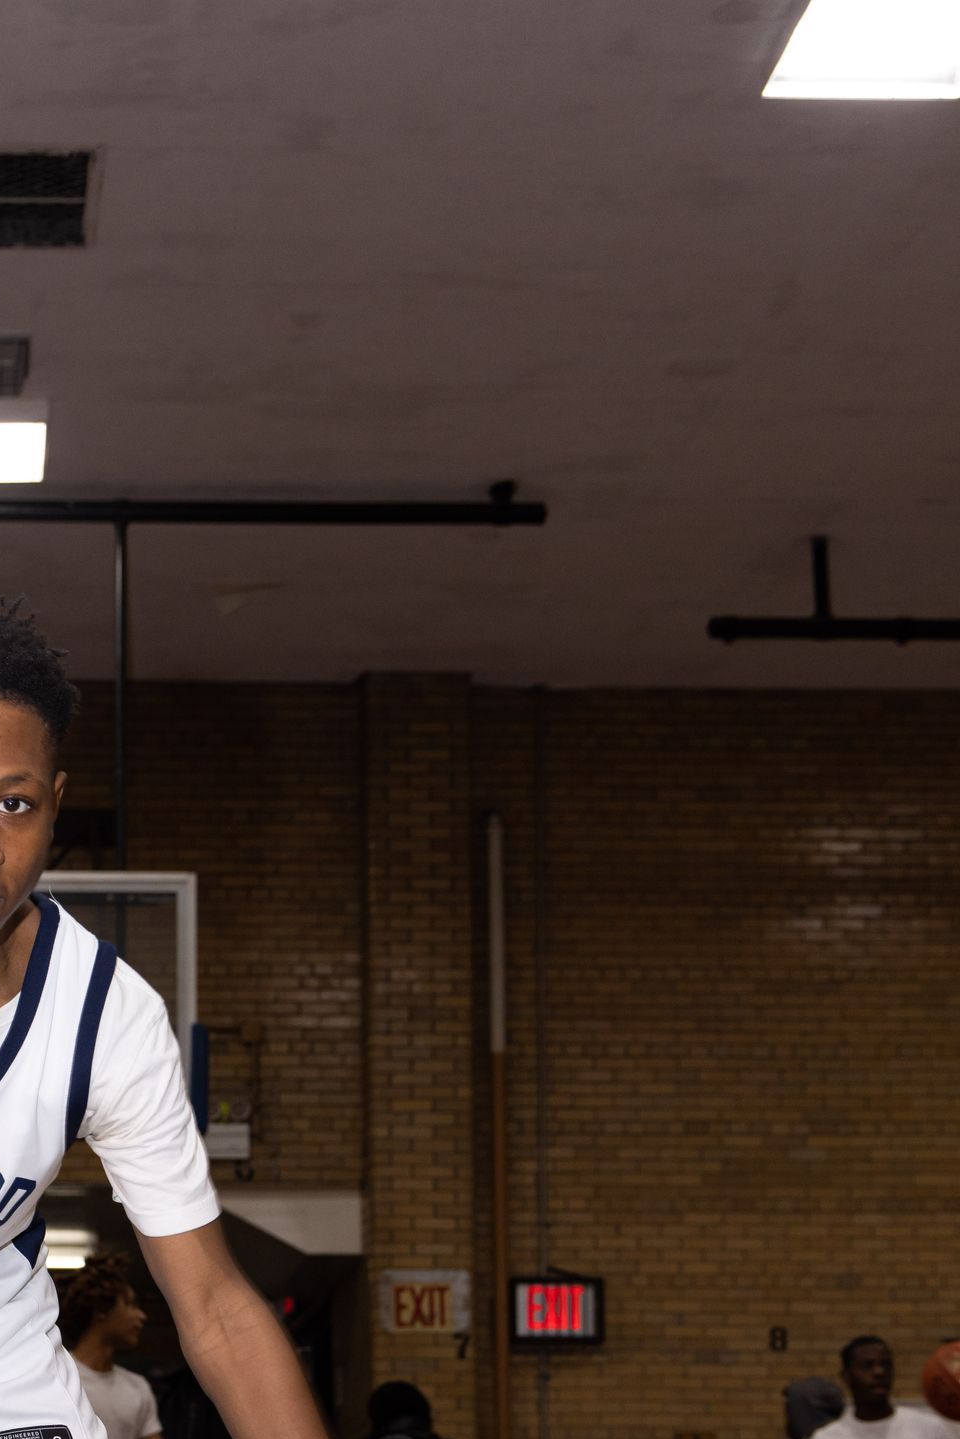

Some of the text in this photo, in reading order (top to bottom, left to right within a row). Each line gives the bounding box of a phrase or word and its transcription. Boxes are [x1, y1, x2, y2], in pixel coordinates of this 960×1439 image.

[393, 1284, 451, 1329] EXIT
[526, 1283, 586, 1332] EXIT
[453, 1332, 470, 1360] 7
[768, 1325, 788, 1353] 8
